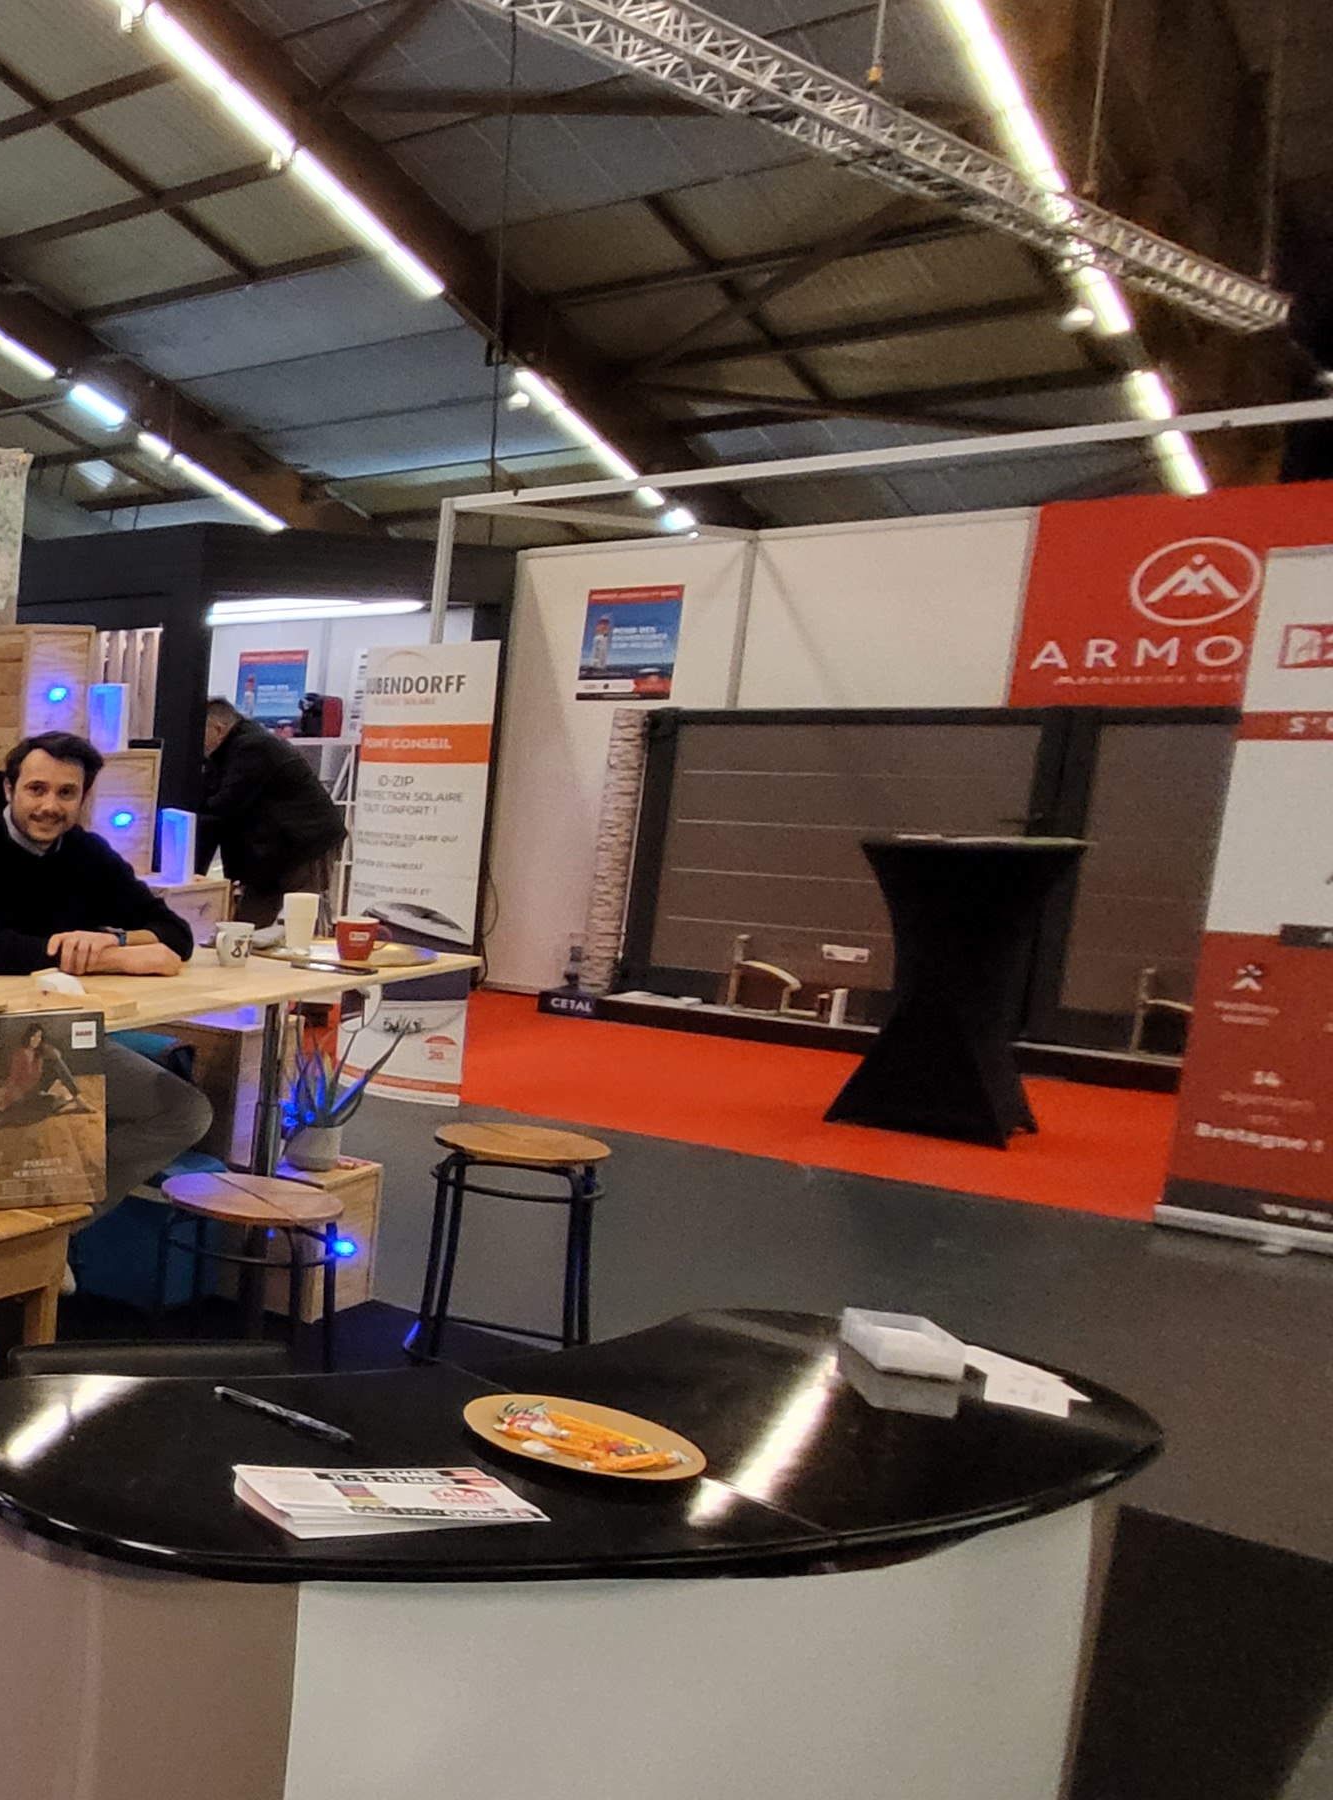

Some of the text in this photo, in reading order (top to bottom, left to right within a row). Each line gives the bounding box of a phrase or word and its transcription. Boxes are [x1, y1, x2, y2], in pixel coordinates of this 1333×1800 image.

[391, 736, 453, 750] CONSEIL
[414, 791, 464, 803] SOLAIRE
[550, 997, 593, 1013] CETAL
[1194, 1121, 1309, 1151] Bretagne
